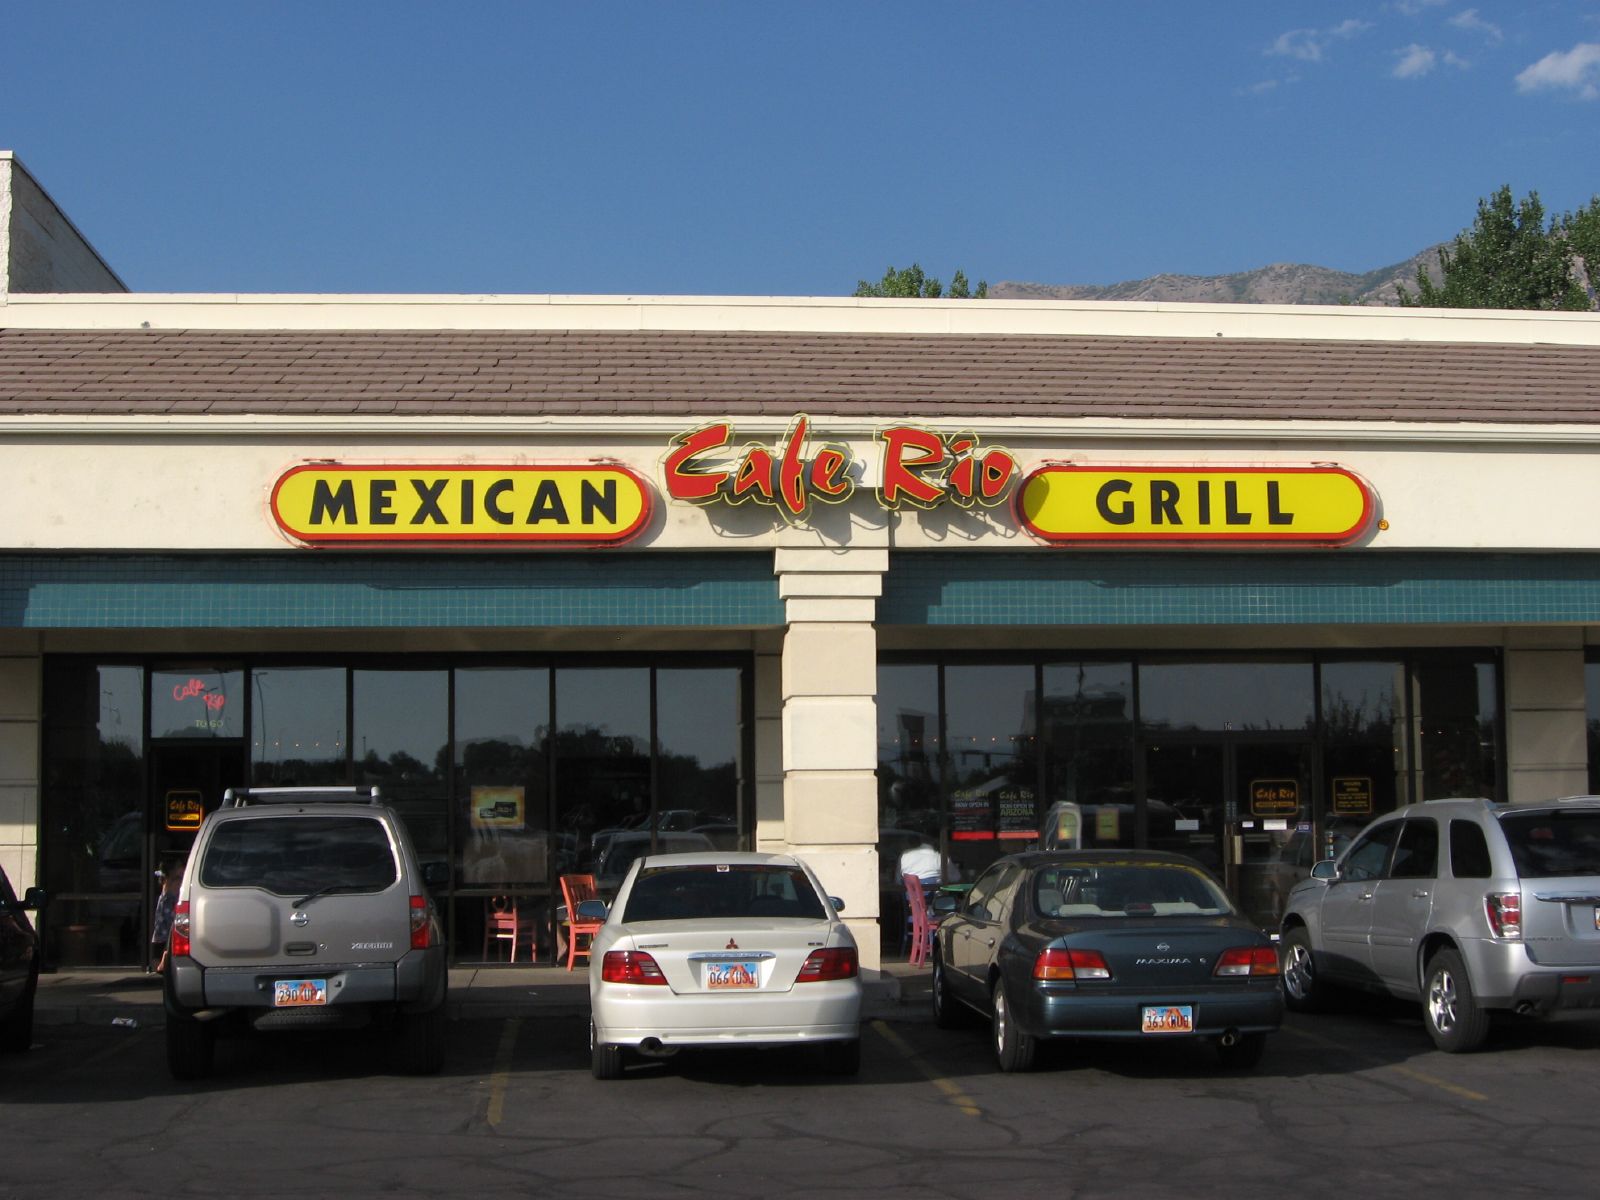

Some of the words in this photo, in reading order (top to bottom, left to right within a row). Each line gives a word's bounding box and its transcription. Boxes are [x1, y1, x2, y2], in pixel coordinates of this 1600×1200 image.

[663, 415, 849, 516] Cafe
[308, 479, 617, 525] MEXICAN
[1095, 479, 1295, 525] GRILL
[1000, 808, 1035, 817] ARIZONA
[709, 971, 729, 985] 066
[278, 989, 297, 1002] 290
[1146, 1015, 1164, 1028] 363
